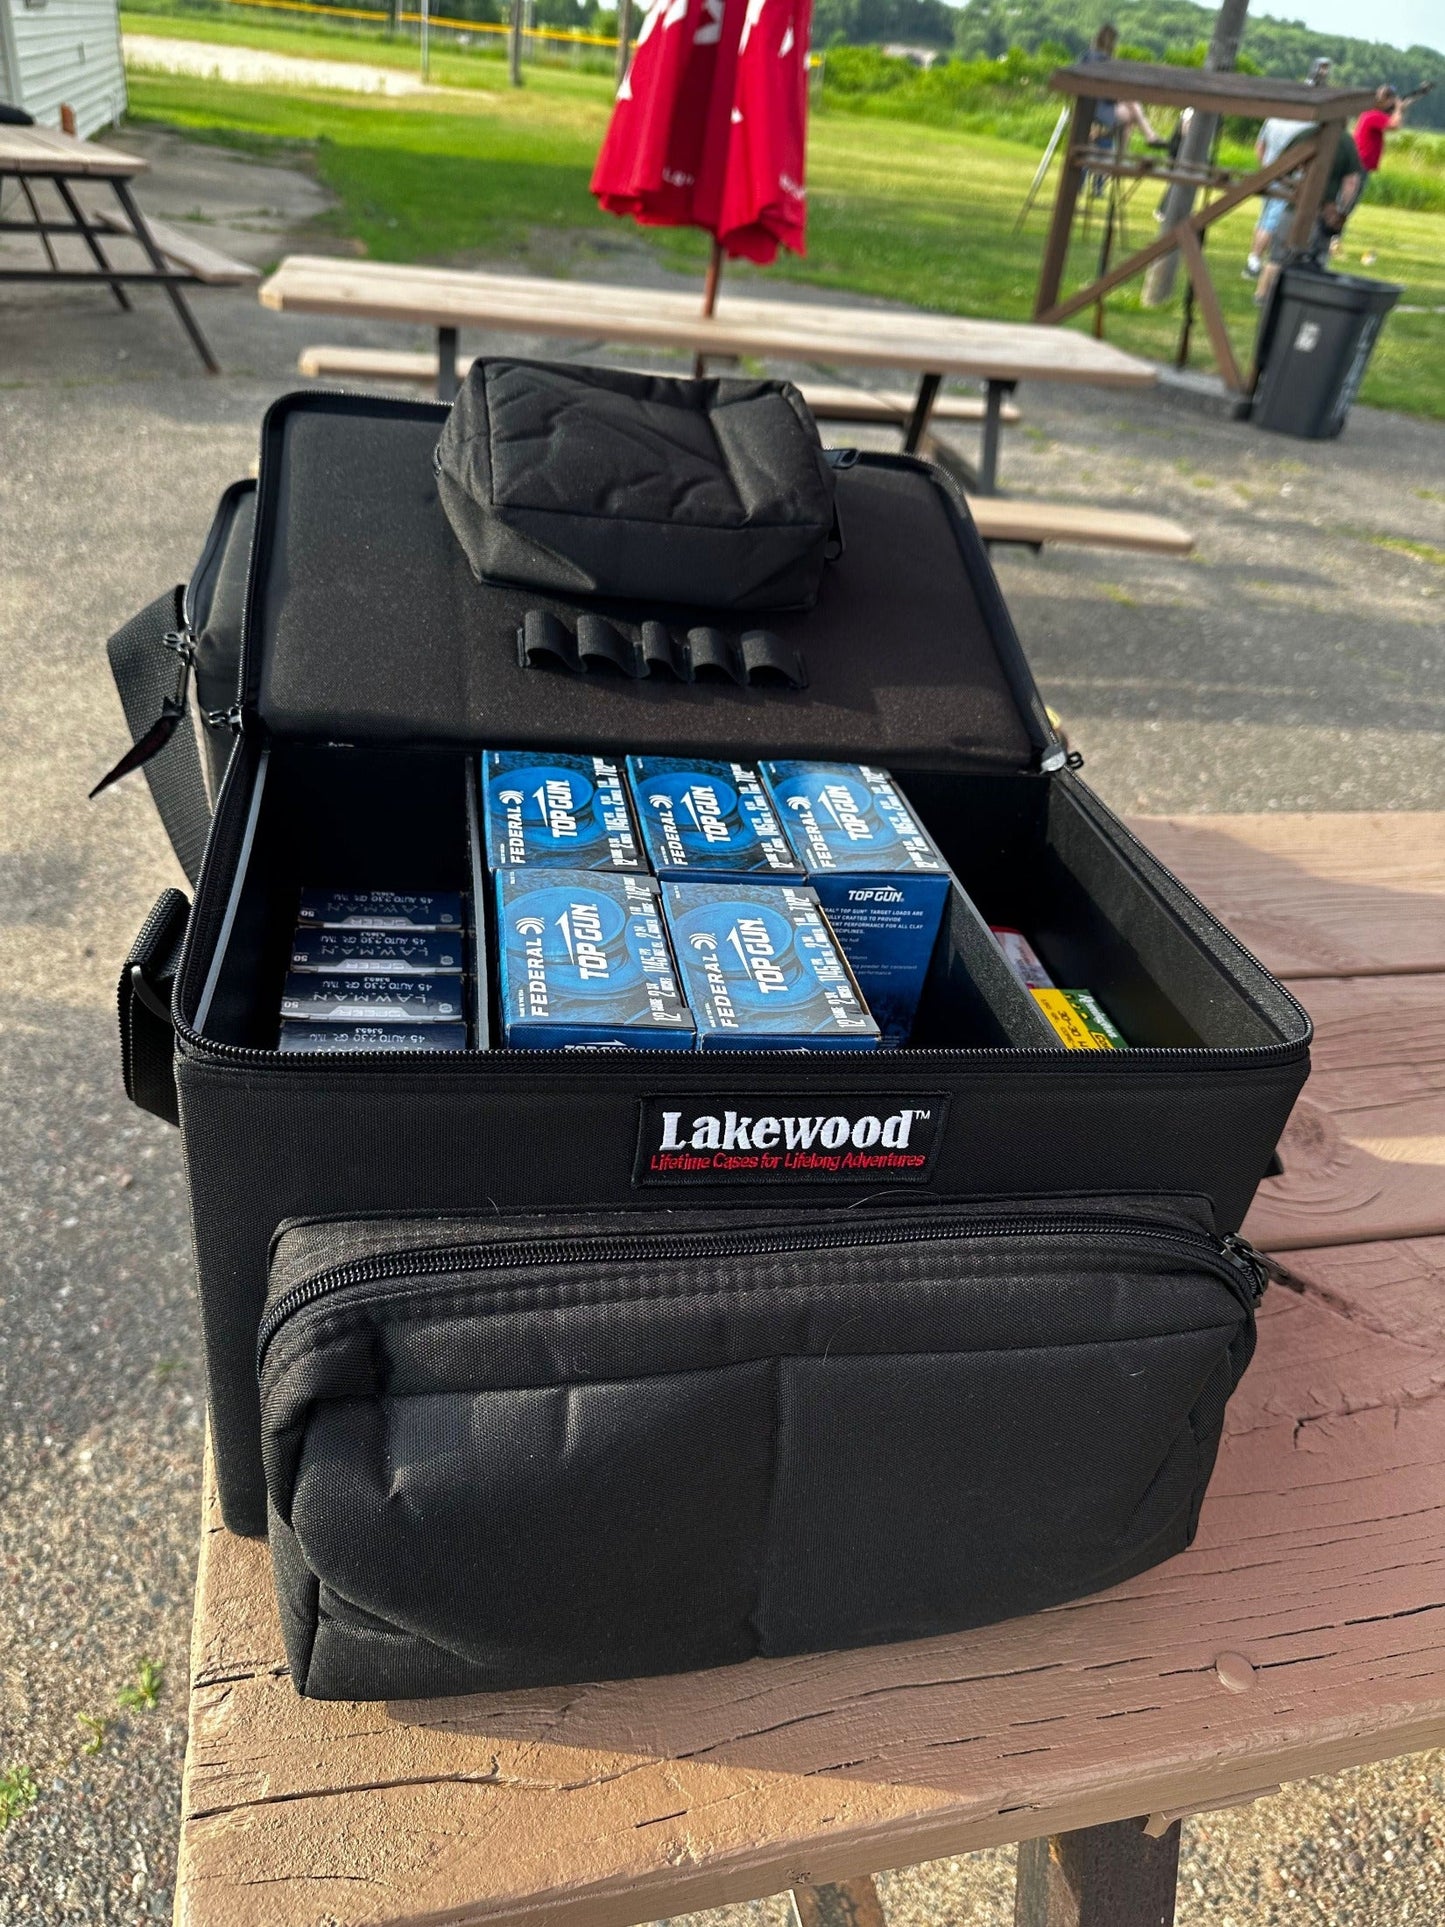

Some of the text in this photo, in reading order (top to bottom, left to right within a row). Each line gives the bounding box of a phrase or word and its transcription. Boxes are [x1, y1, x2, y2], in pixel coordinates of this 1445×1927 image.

[546, 780, 577, 838] TOP GUN
[690, 786, 731, 843] TOP GUN
[824, 785, 873, 840] TOP GUN
[507, 806, 526, 864] FEDERAL
[660, 810, 688, 866] FEDERAL
[800, 809, 836, 868] FEDERAL
[848, 890, 902, 902] TOP GUN
[321, 946, 428, 956] LAWMAN
[570, 904, 609, 980] TOP GUN
[736, 918, 788, 994] TOP GUN
[526, 938, 549, 1016] FEDERAL
[642, 955, 670, 972] 1145
[814, 965, 846, 982] 1145
[313, 991, 426, 1003] LAWMAN
[388, 982, 414, 990] AUTO
[702, 954, 738, 1028] FEDERAL
[652, 1013, 681, 1022] 12
[838, 1018, 866, 1028] 12
[379, 1034, 406, 1042] AUTO
[410, 1035, 426, 1044] 45
[659, 1110, 913, 1150] Lakewood
[650, 1152, 926, 1171] Lifetime Cases for Lifelong Adventures
